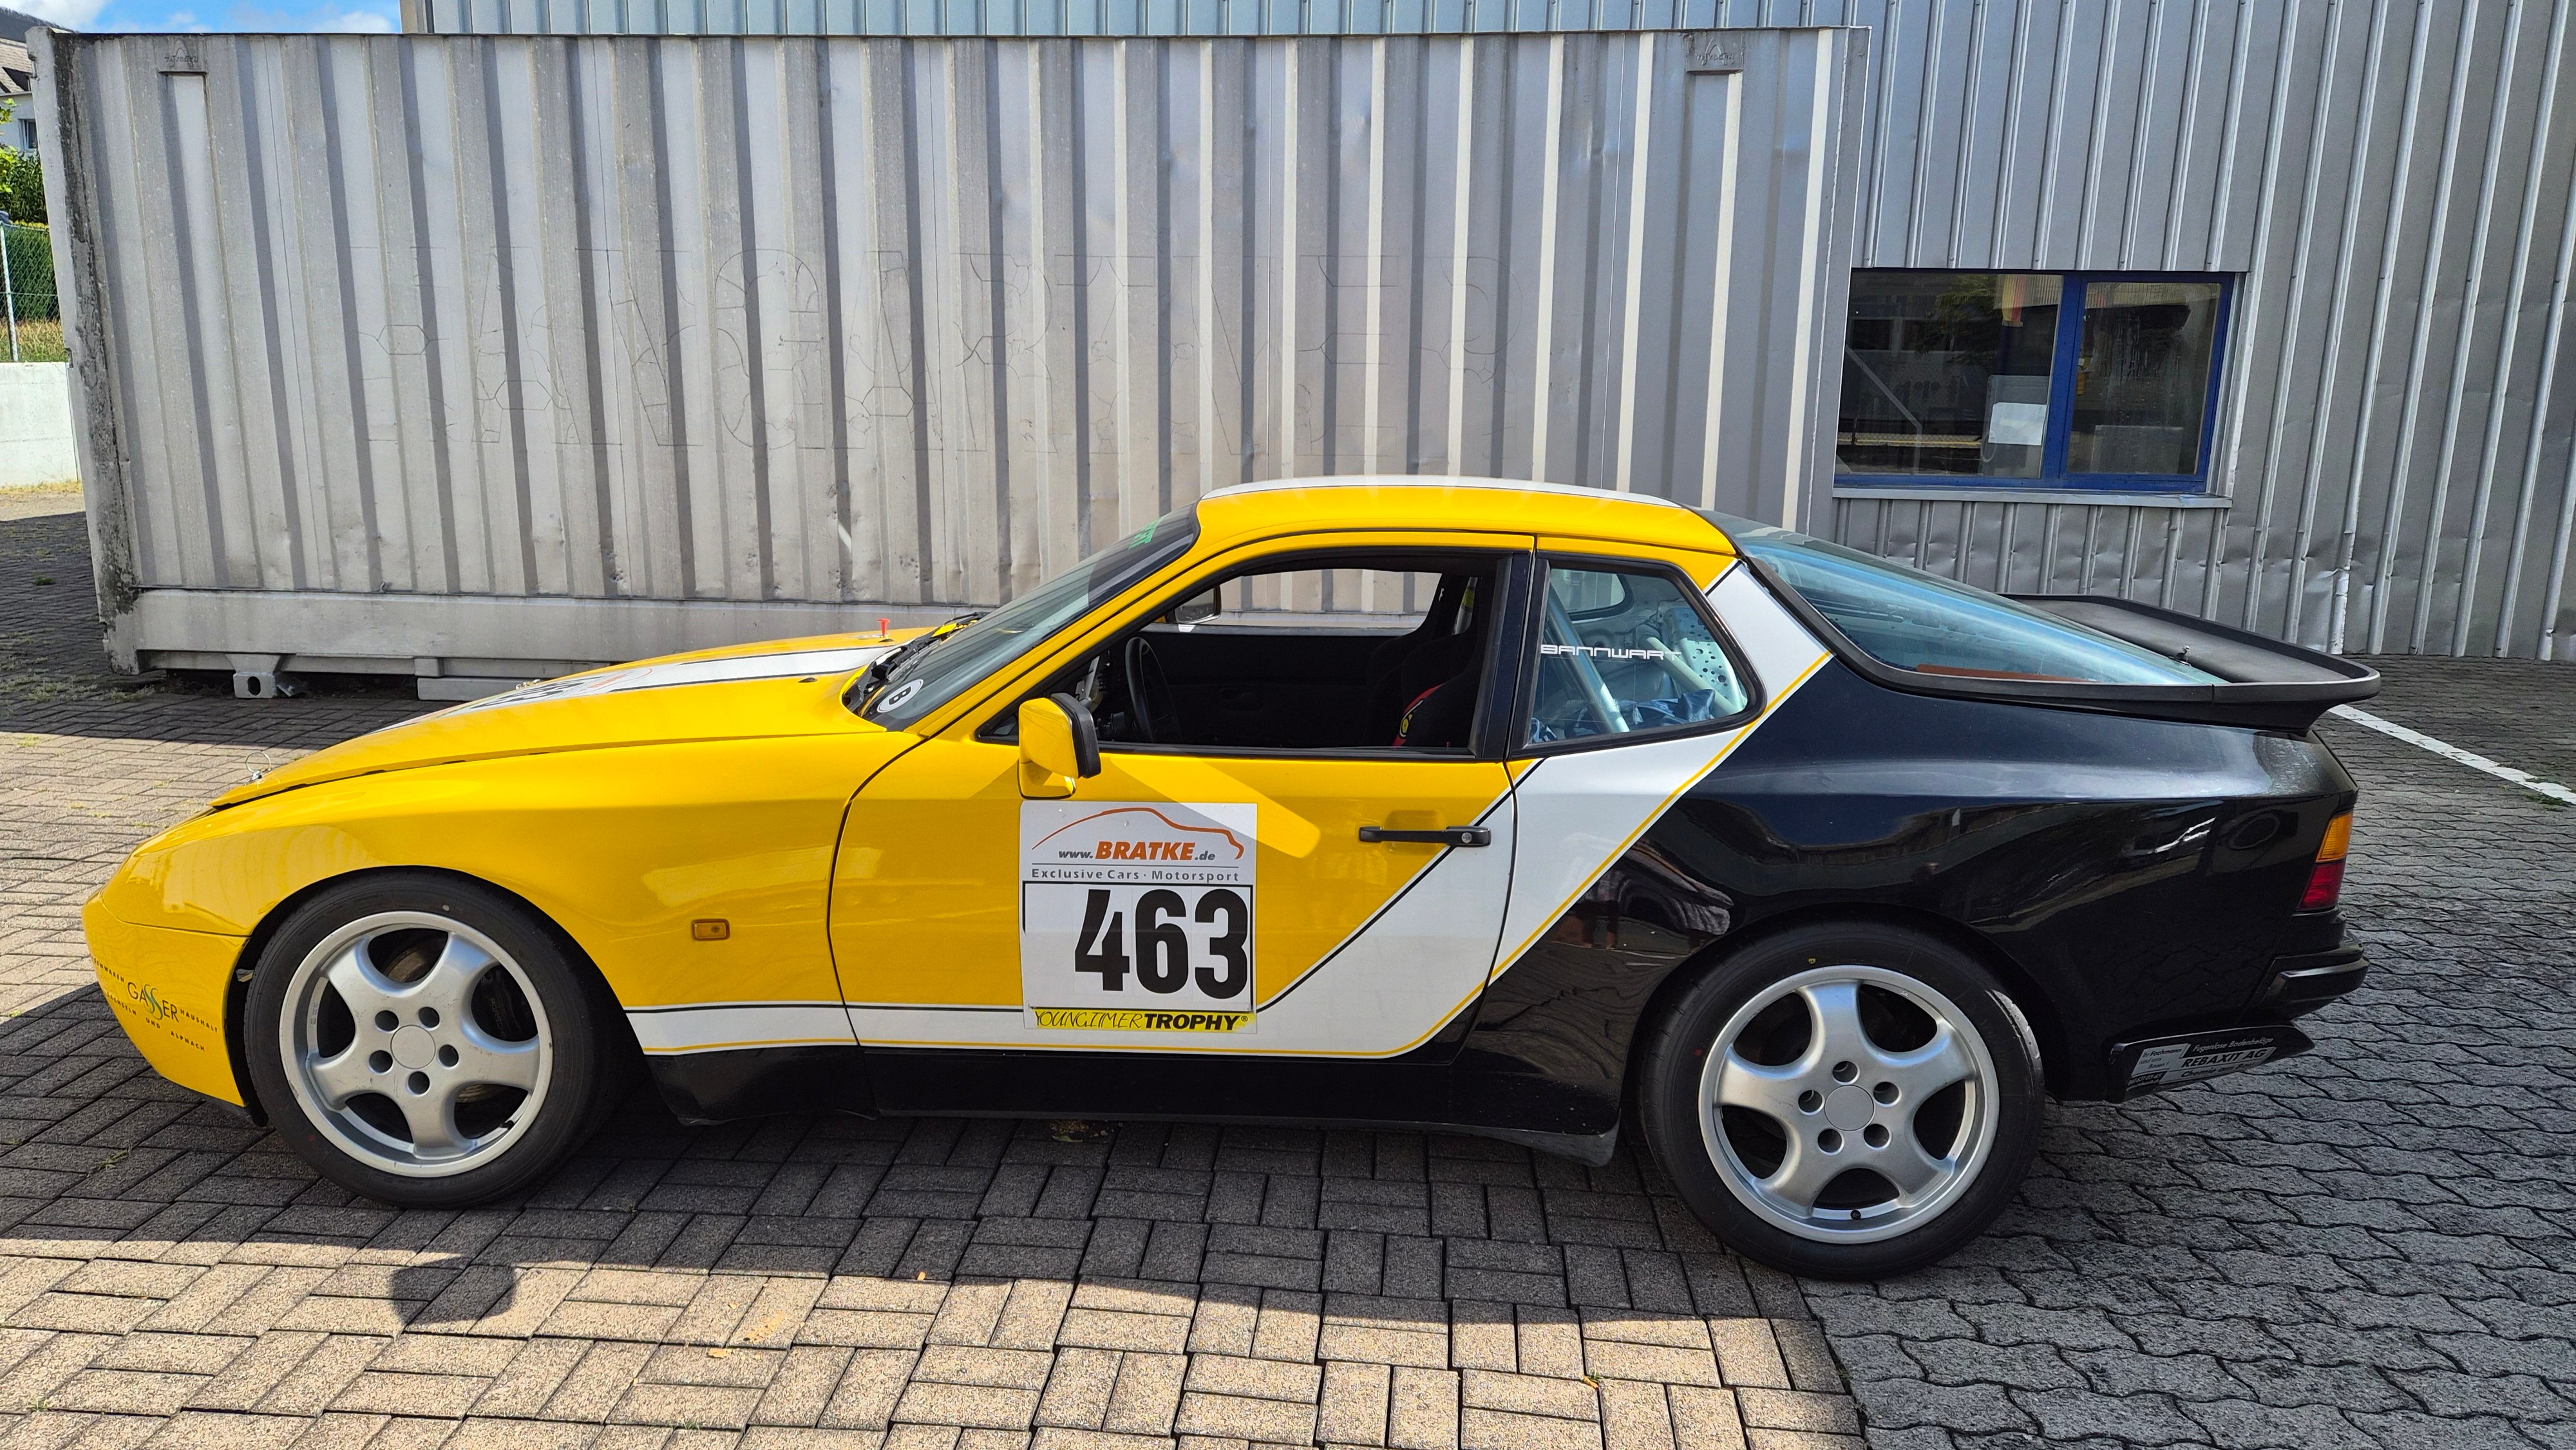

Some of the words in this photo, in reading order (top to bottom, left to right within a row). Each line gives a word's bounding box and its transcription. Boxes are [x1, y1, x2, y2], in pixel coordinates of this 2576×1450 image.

[1540, 644, 1682, 660] BANNWART
[889, 686, 912, 706] B
[1031, 868, 1103, 880] Exclusive
[1107, 869, 1139, 880] Cars
[1151, 870, 1239, 883] Motorsport
[1074, 889, 1249, 1000] 463
[127, 981, 180, 1023] GASSER
[180, 1008, 218, 1033] HAUSHALT
[146, 1017, 160, 1029] UND
[171, 1030, 205, 1052] ALPNACH
[2193, 1041, 2227, 1053] Fugenlose
[2181, 1052, 2243, 1068] REBAXIT
[2242, 1049, 2268, 1060] AG
[2181, 1067, 2217, 1078] Chemie
